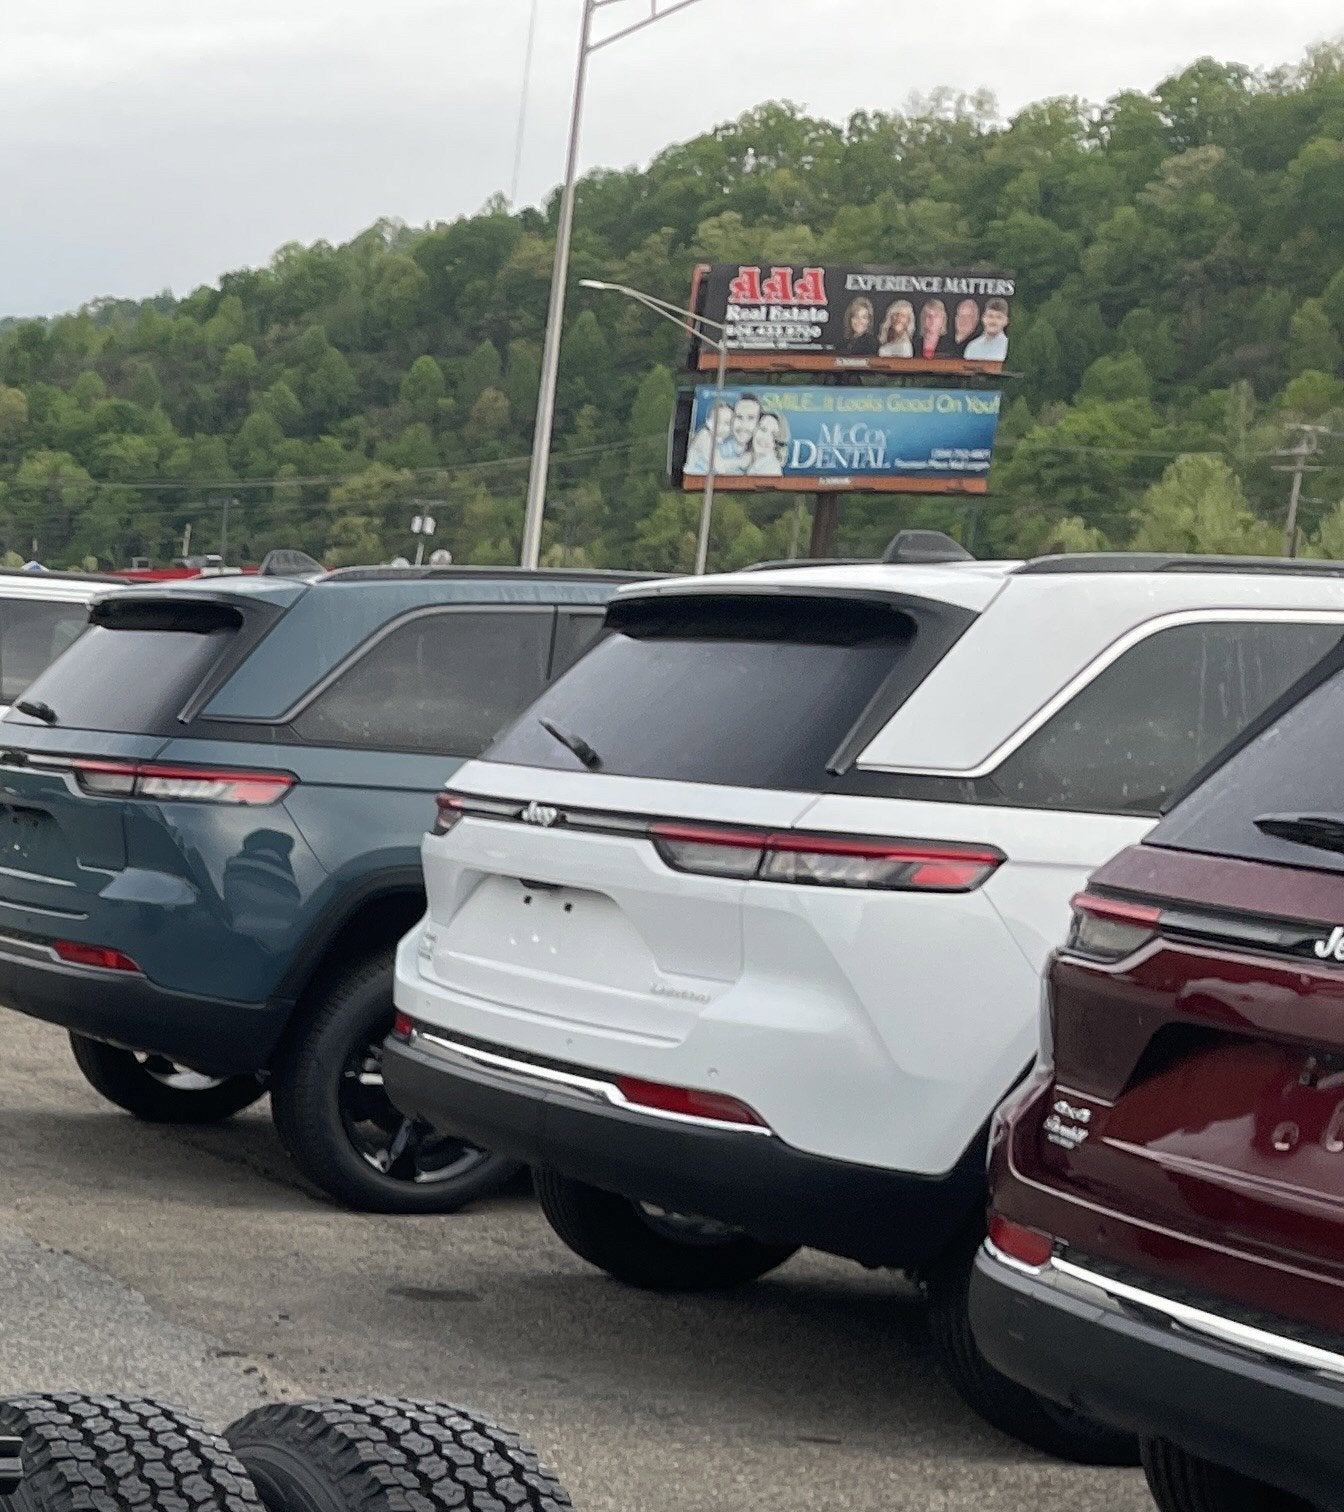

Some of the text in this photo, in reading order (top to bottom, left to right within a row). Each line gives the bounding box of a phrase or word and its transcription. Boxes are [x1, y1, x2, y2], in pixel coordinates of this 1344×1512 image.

[844, 273, 1016, 297] EXPERIENCE MATTERS
[725, 304, 830, 323] Real Estate
[886, 393, 934, 413] Good
